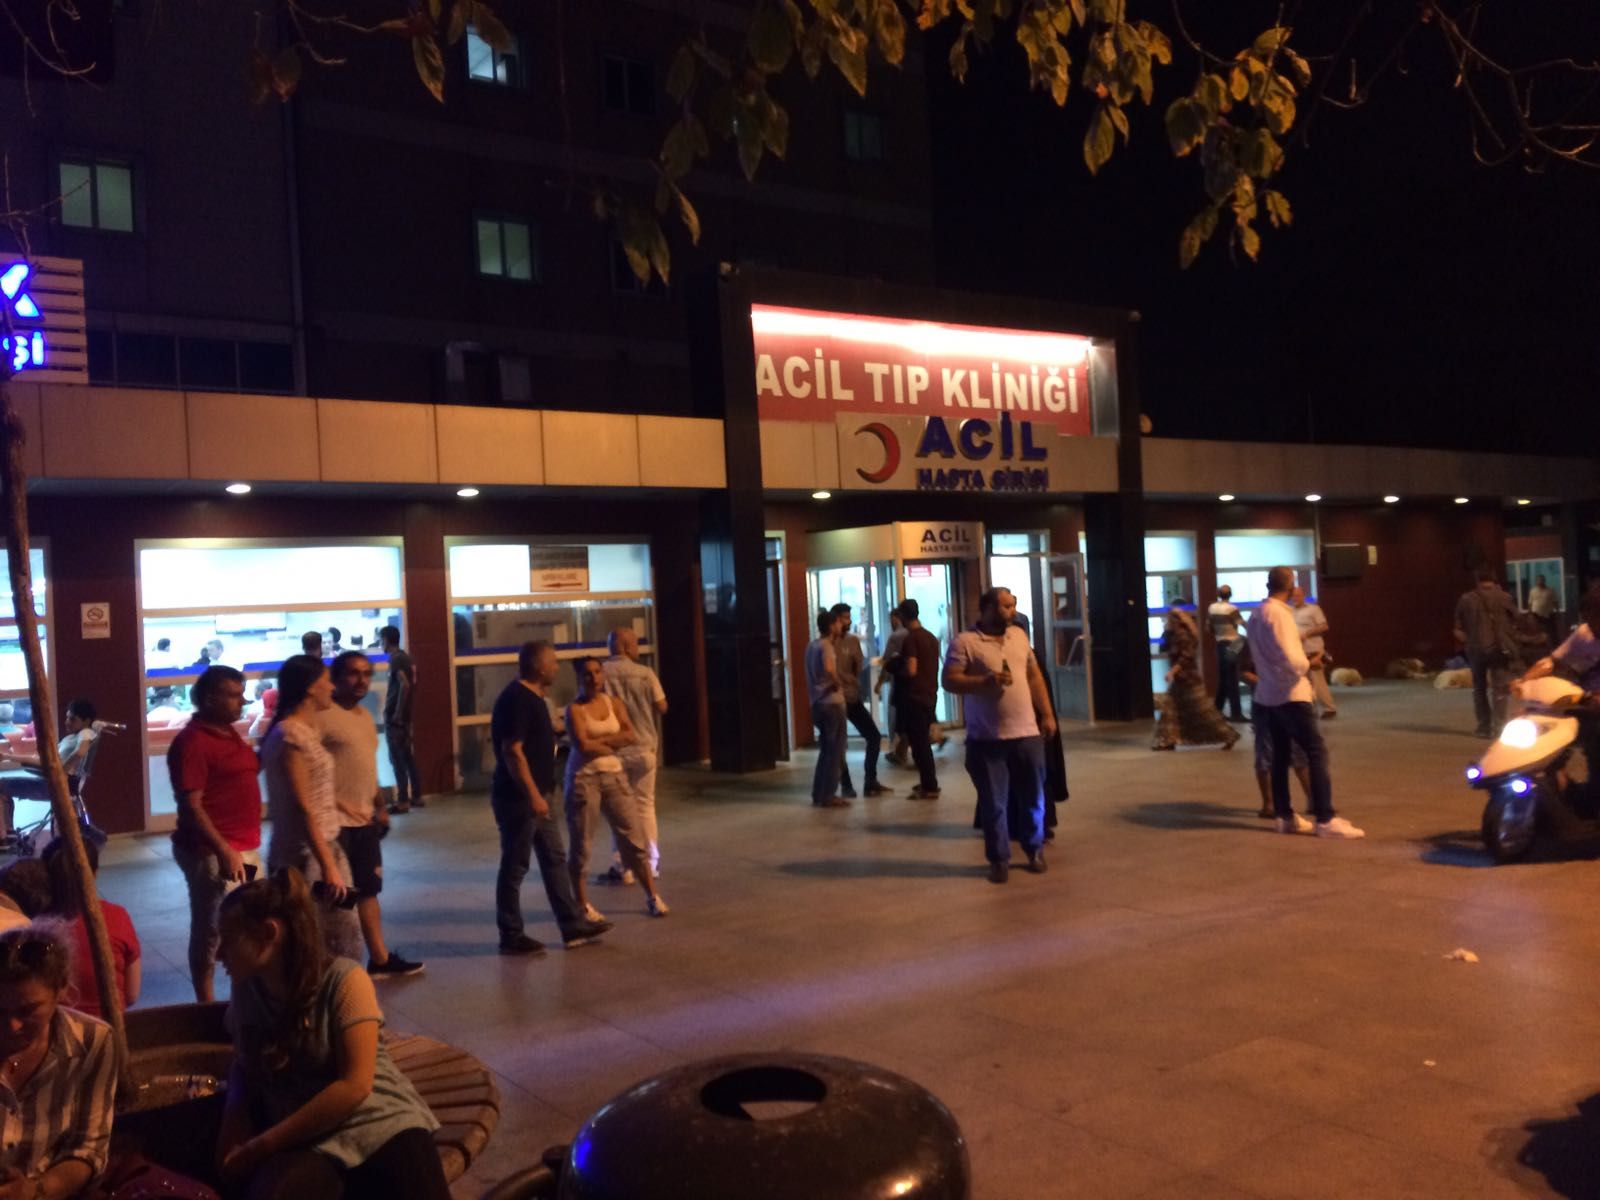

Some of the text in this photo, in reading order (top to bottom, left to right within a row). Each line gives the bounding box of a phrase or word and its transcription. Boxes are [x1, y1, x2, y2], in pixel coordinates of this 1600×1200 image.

[756, 348, 1079, 413] ACİL TIP KLİNİĞİ
[915, 411, 1048, 461] ACİL
[916, 468, 985, 490] HASTA
[921, 526, 971, 543] ACİL
